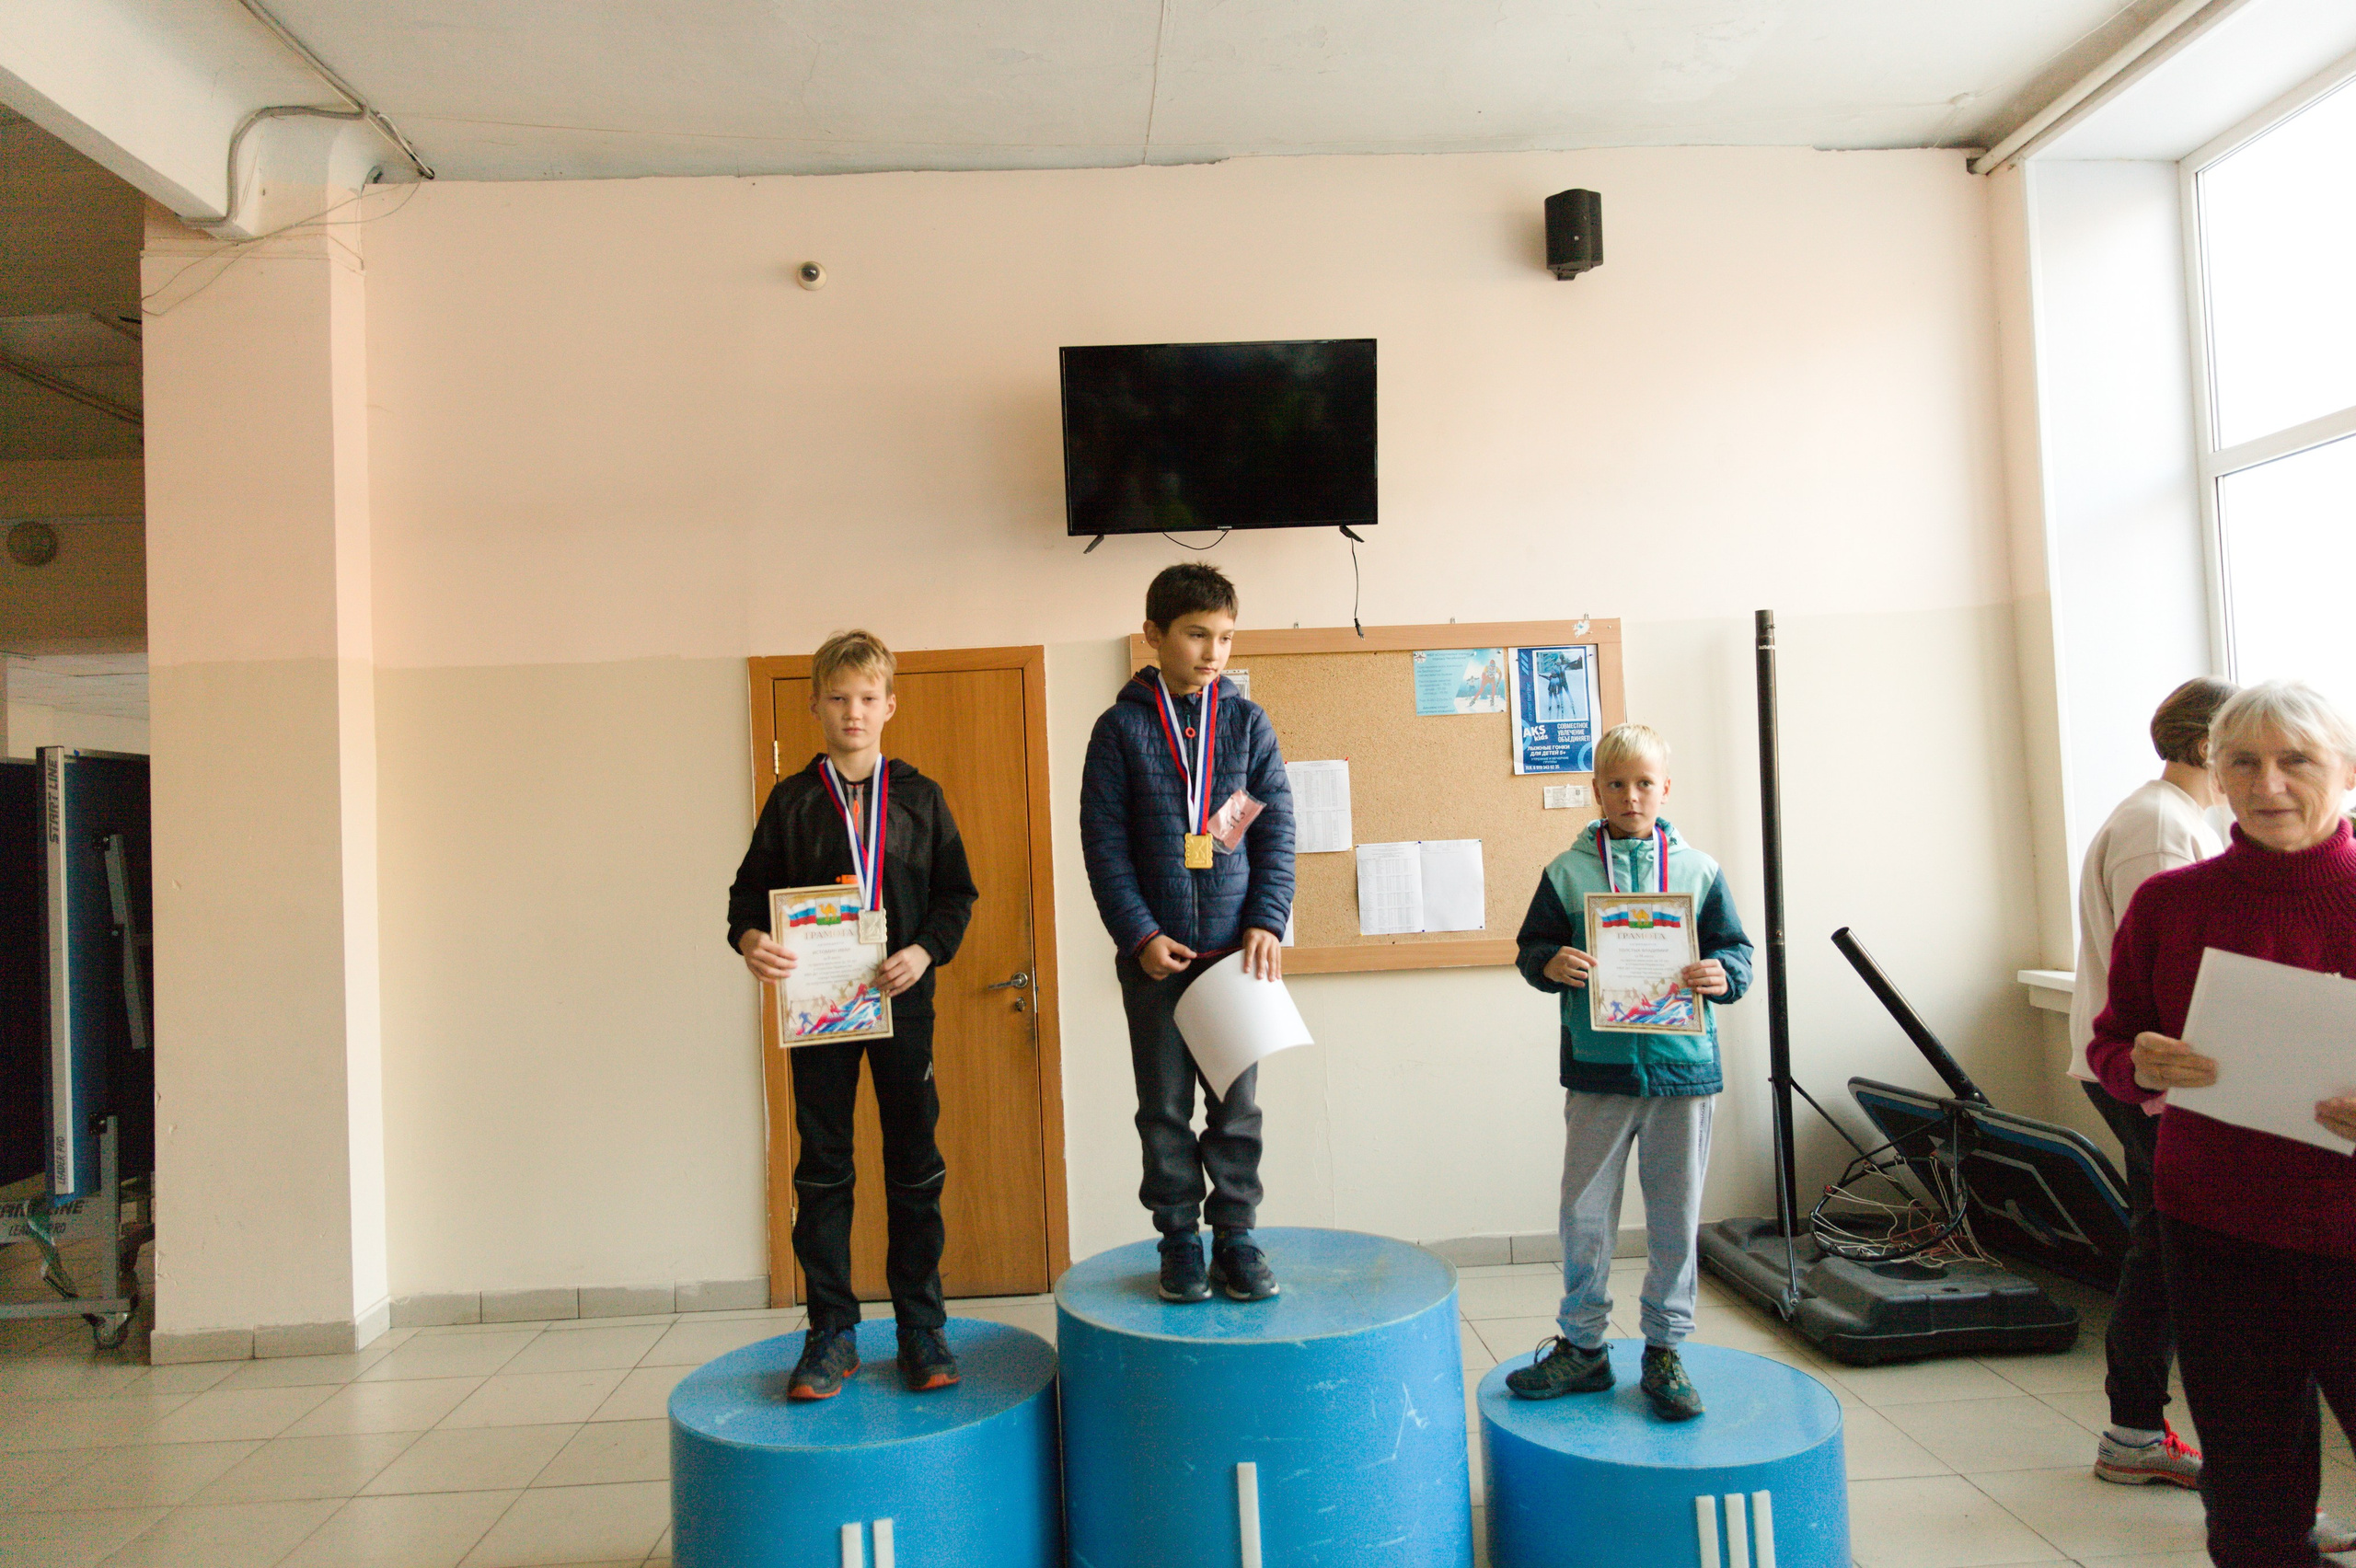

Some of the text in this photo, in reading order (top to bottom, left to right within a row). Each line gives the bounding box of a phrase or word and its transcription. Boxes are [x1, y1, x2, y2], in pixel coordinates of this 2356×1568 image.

[1523, 725, 1546, 738] AKS
[47, 757, 59, 844] START LINE
[804, 928, 854, 940] ГРАМОТА
[1617, 932, 1667, 940] ГРАМОТА
[55, 1136, 65, 1185] LEADER PRO
